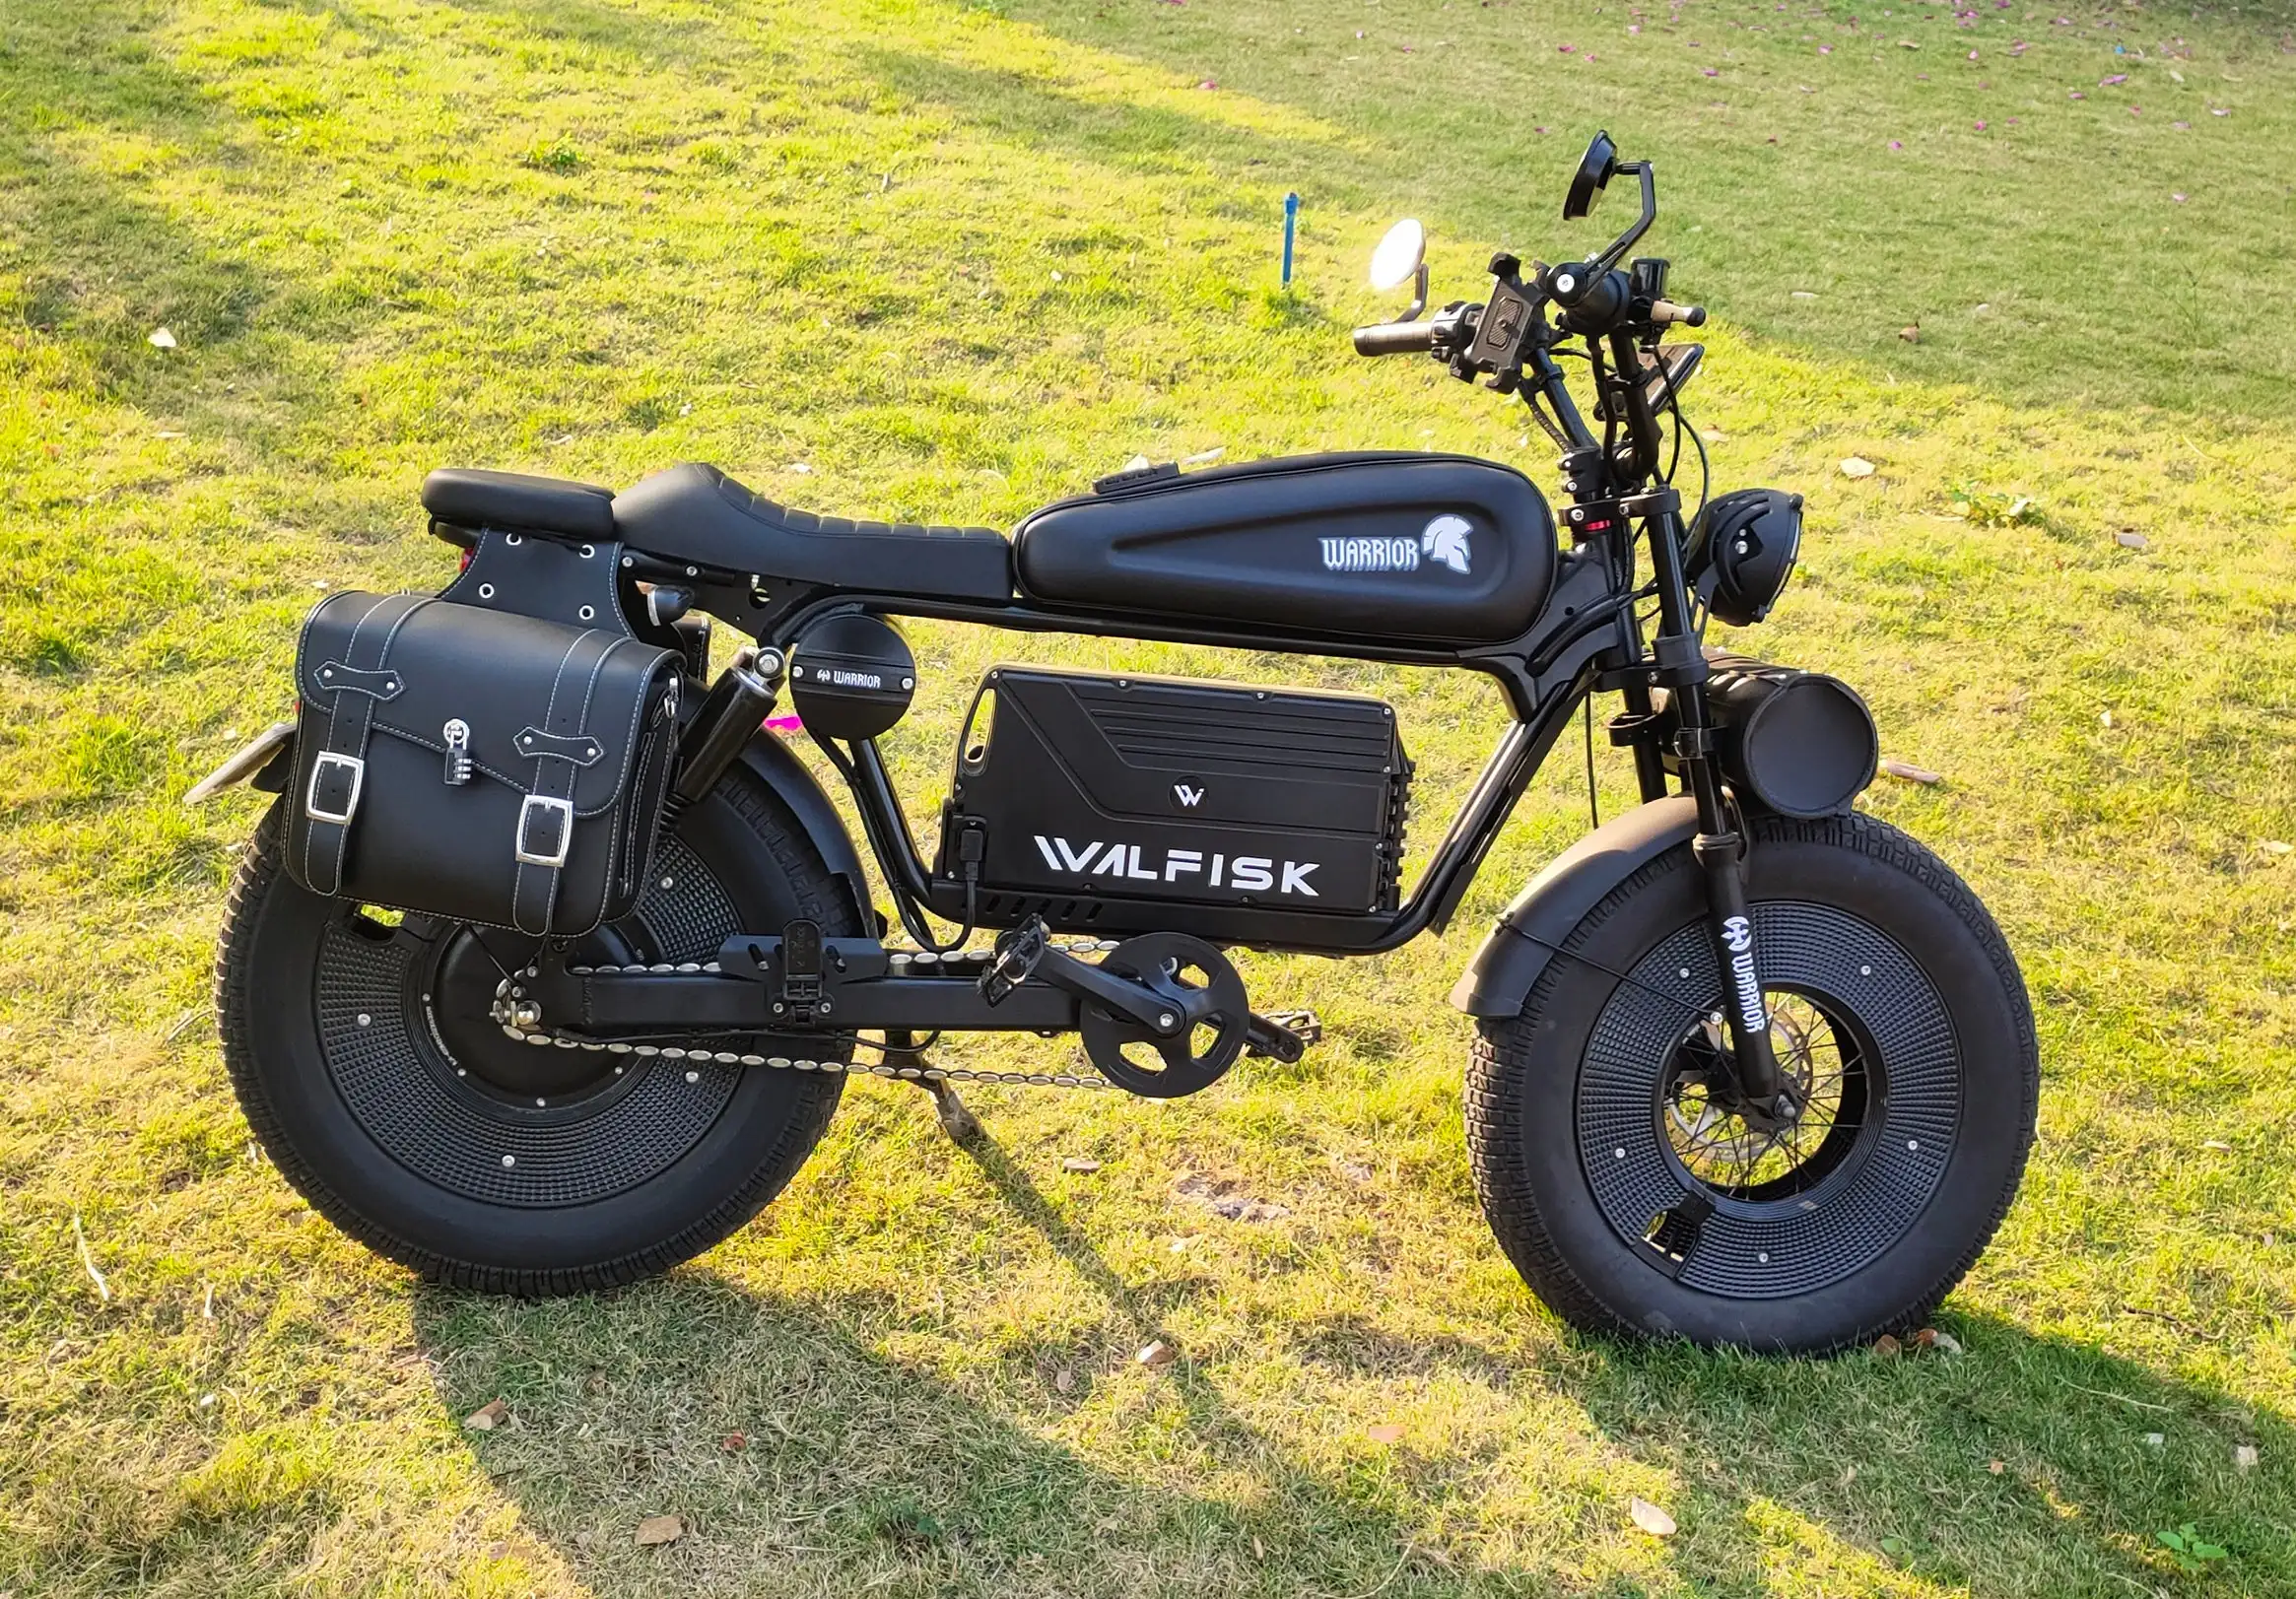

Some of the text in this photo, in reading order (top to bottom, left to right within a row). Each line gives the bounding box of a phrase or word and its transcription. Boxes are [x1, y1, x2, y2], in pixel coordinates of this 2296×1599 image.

[1317, 537, 1420, 571] WARRIOR
[834, 671, 881, 689] WARRIOR
[1034, 835, 1319, 897] WALFISK
[1731, 952, 1766, 1033] WARRIOR
